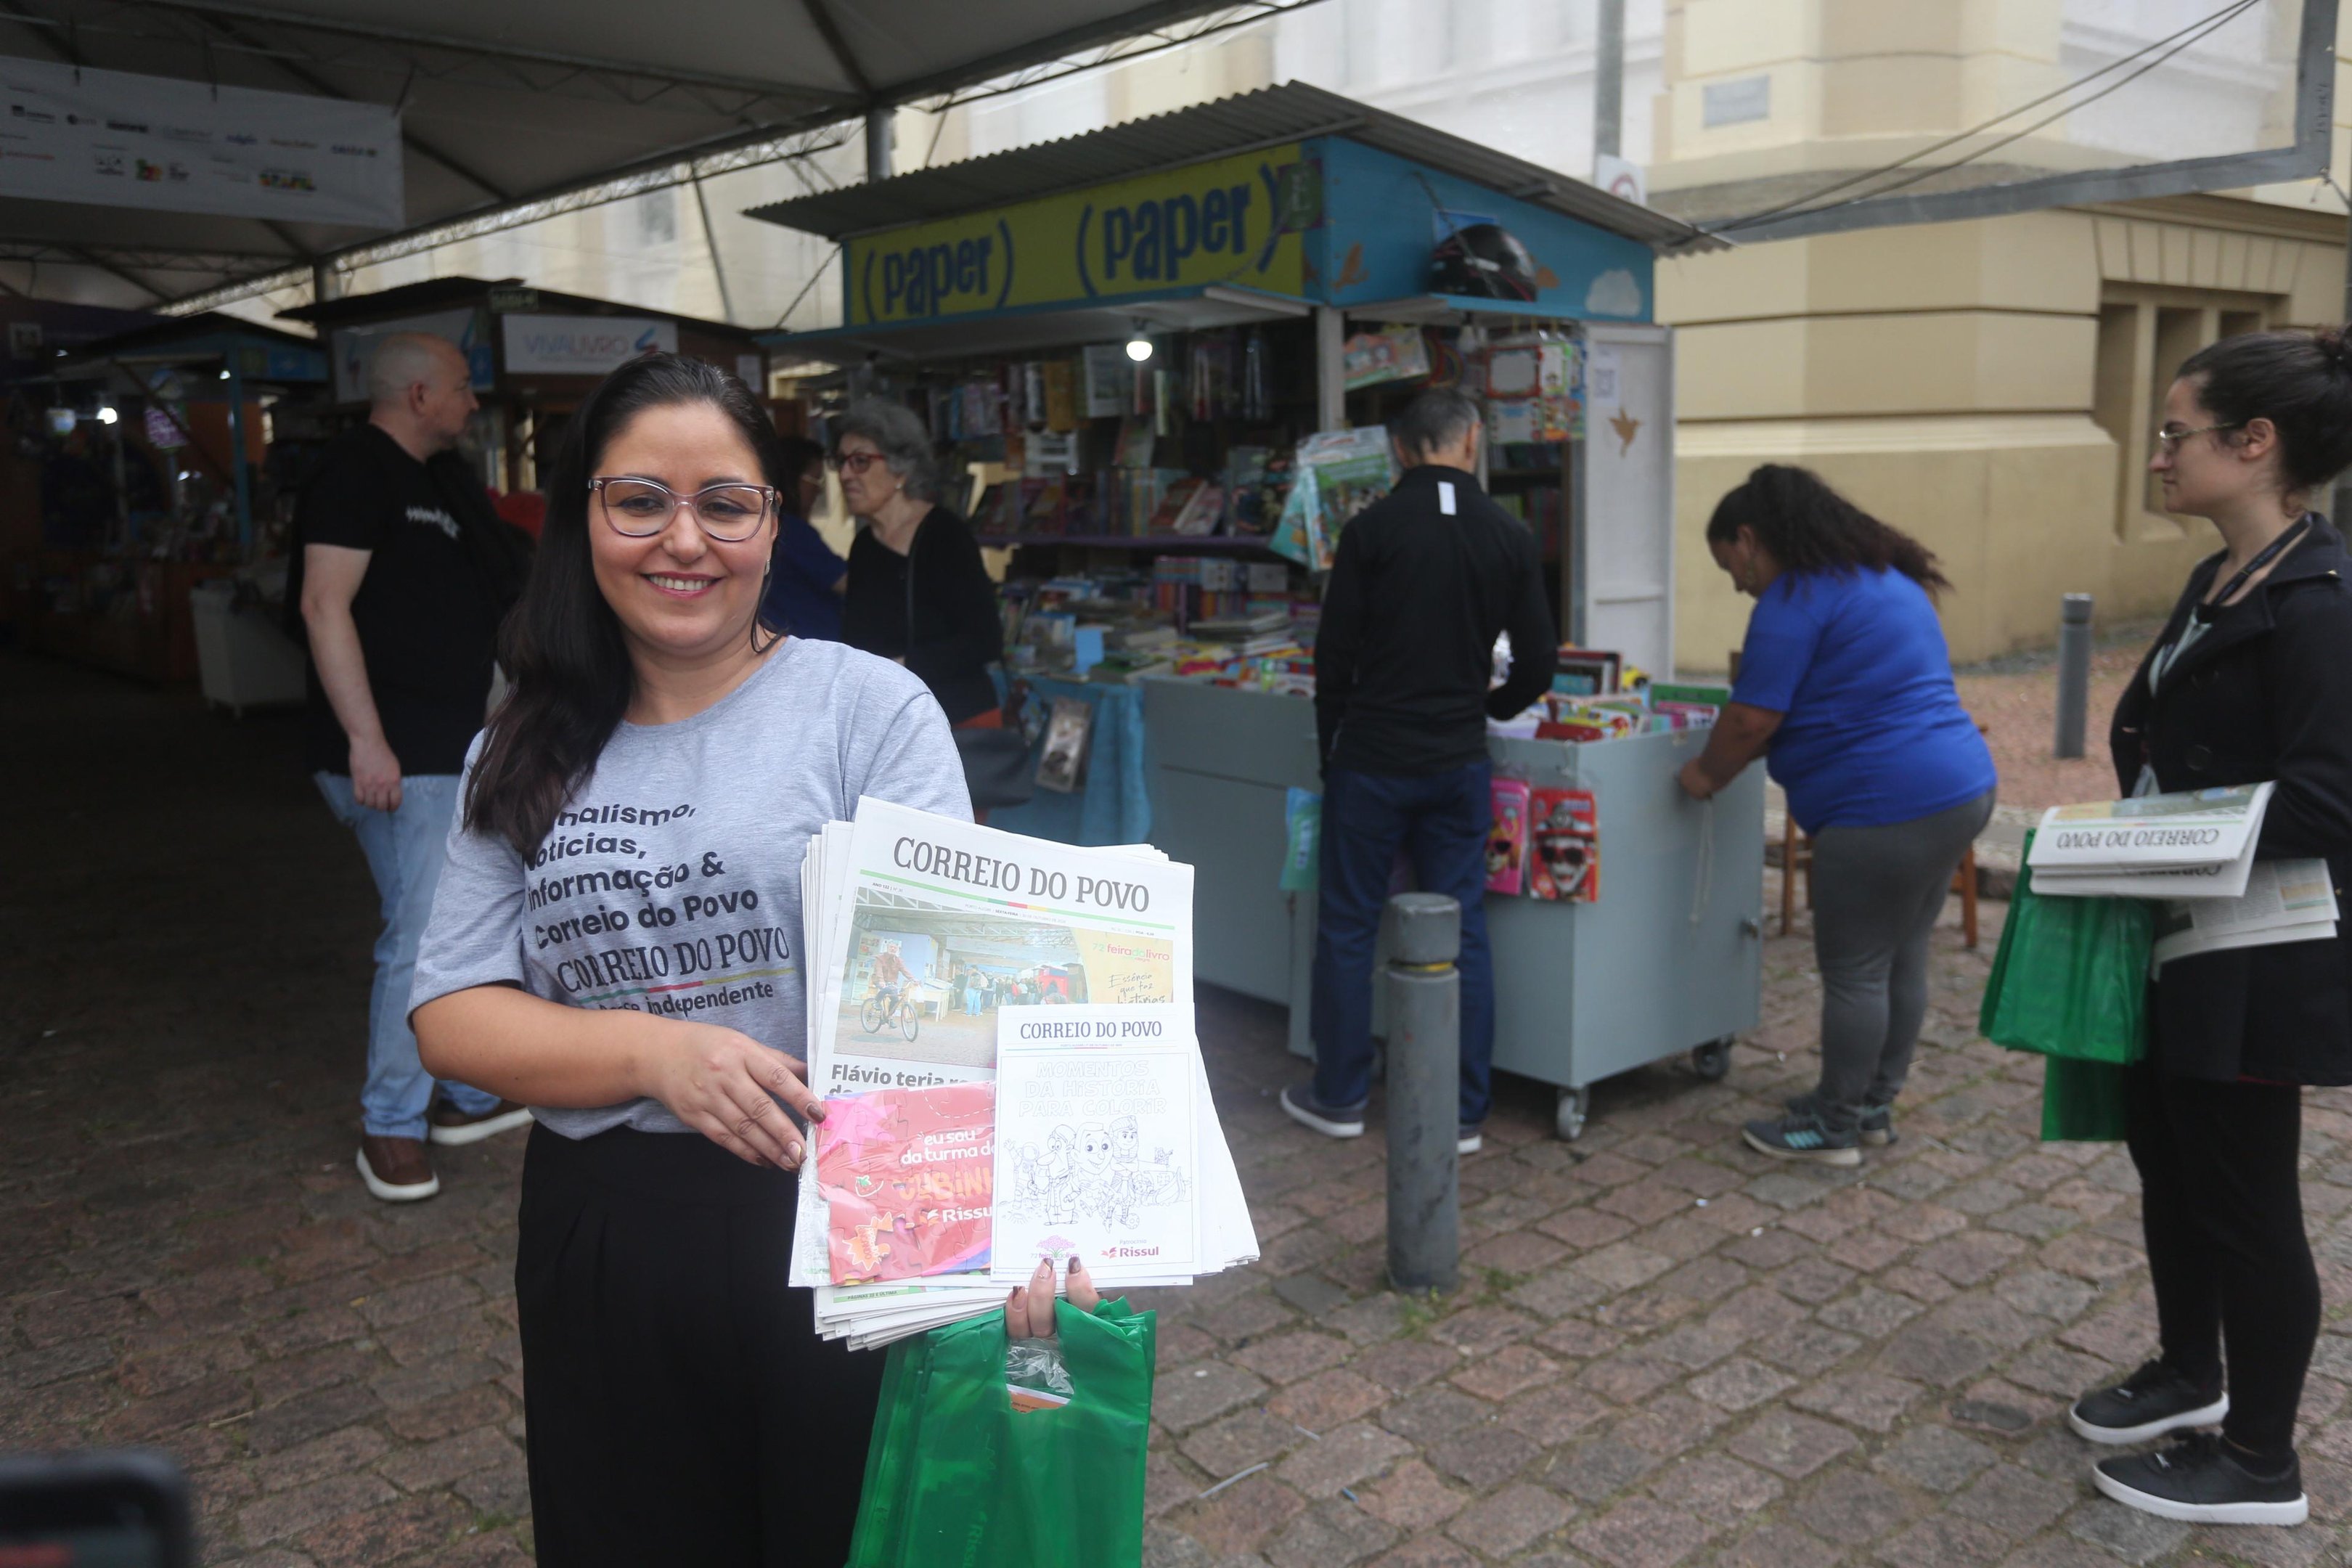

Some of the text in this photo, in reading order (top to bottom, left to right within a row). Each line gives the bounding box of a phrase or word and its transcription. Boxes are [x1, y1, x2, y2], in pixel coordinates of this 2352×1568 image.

[558, 804, 696, 826] nalismo,
[2056, 829, 2220, 850] CORREIO DO POVO
[701, 852, 725, 877] &
[894, 836, 1151, 913] CORREIO DO POVO
[535, 886, 759, 950] Correio do Povo
[557, 926, 790, 992] CORREIO DO POVO
[645, 981, 774, 1017] independente
[1020, 1021, 1162, 1039] CORREIO DO POVO
[831, 1064, 891, 1085] Flávio
[1036, 1060, 1150, 1078] MOMENTOS
[1025, 1081, 1054, 1098] DA
[1019, 1101, 1073, 1117] PARA
[924, 1130, 976, 1146] eu sou
[901, 1150, 923, 1165] da
[925, 1146, 978, 1162] turma
[942, 1206, 992, 1222] Rissu
[1119, 1246, 1159, 1257] Rissul
